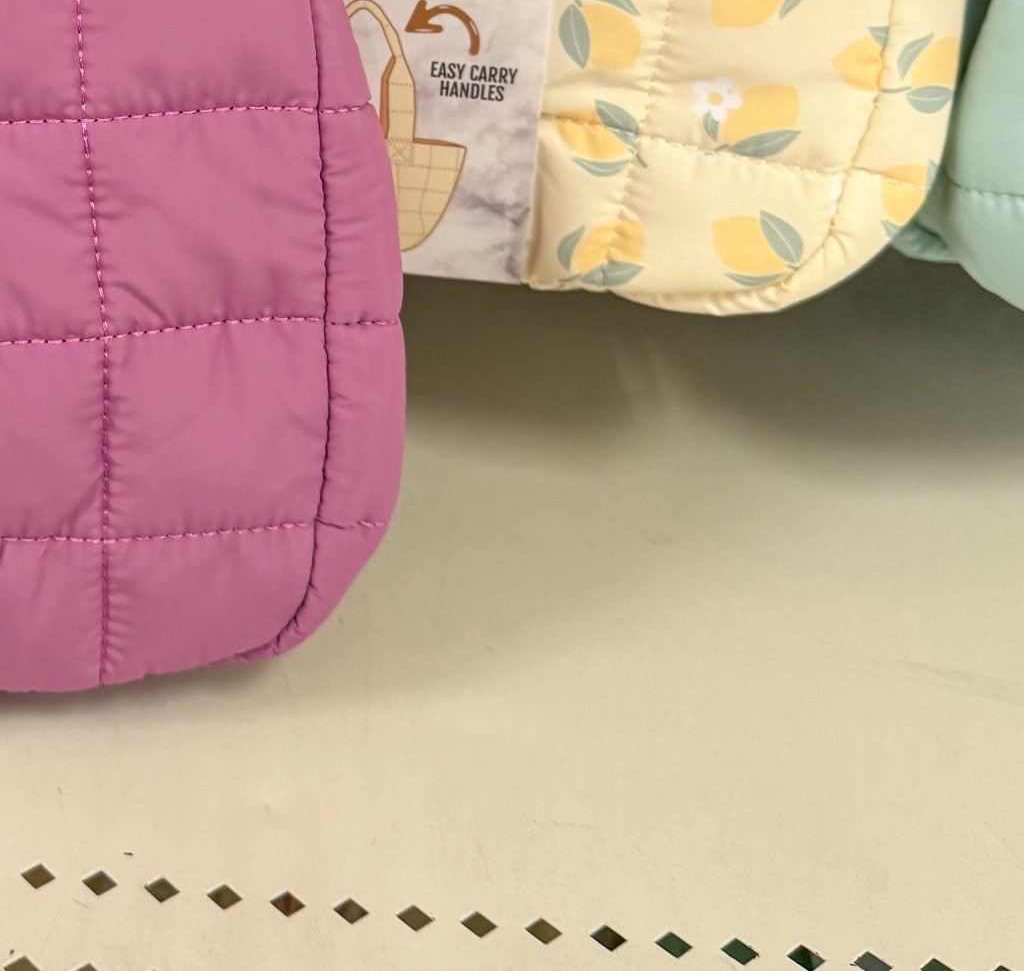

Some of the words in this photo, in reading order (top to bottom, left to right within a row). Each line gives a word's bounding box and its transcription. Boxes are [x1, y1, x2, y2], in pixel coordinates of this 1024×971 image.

[430, 62, 466, 79] EASY
[470, 65, 518, 85] CARRY
[439, 81, 505, 102] HANDLES
